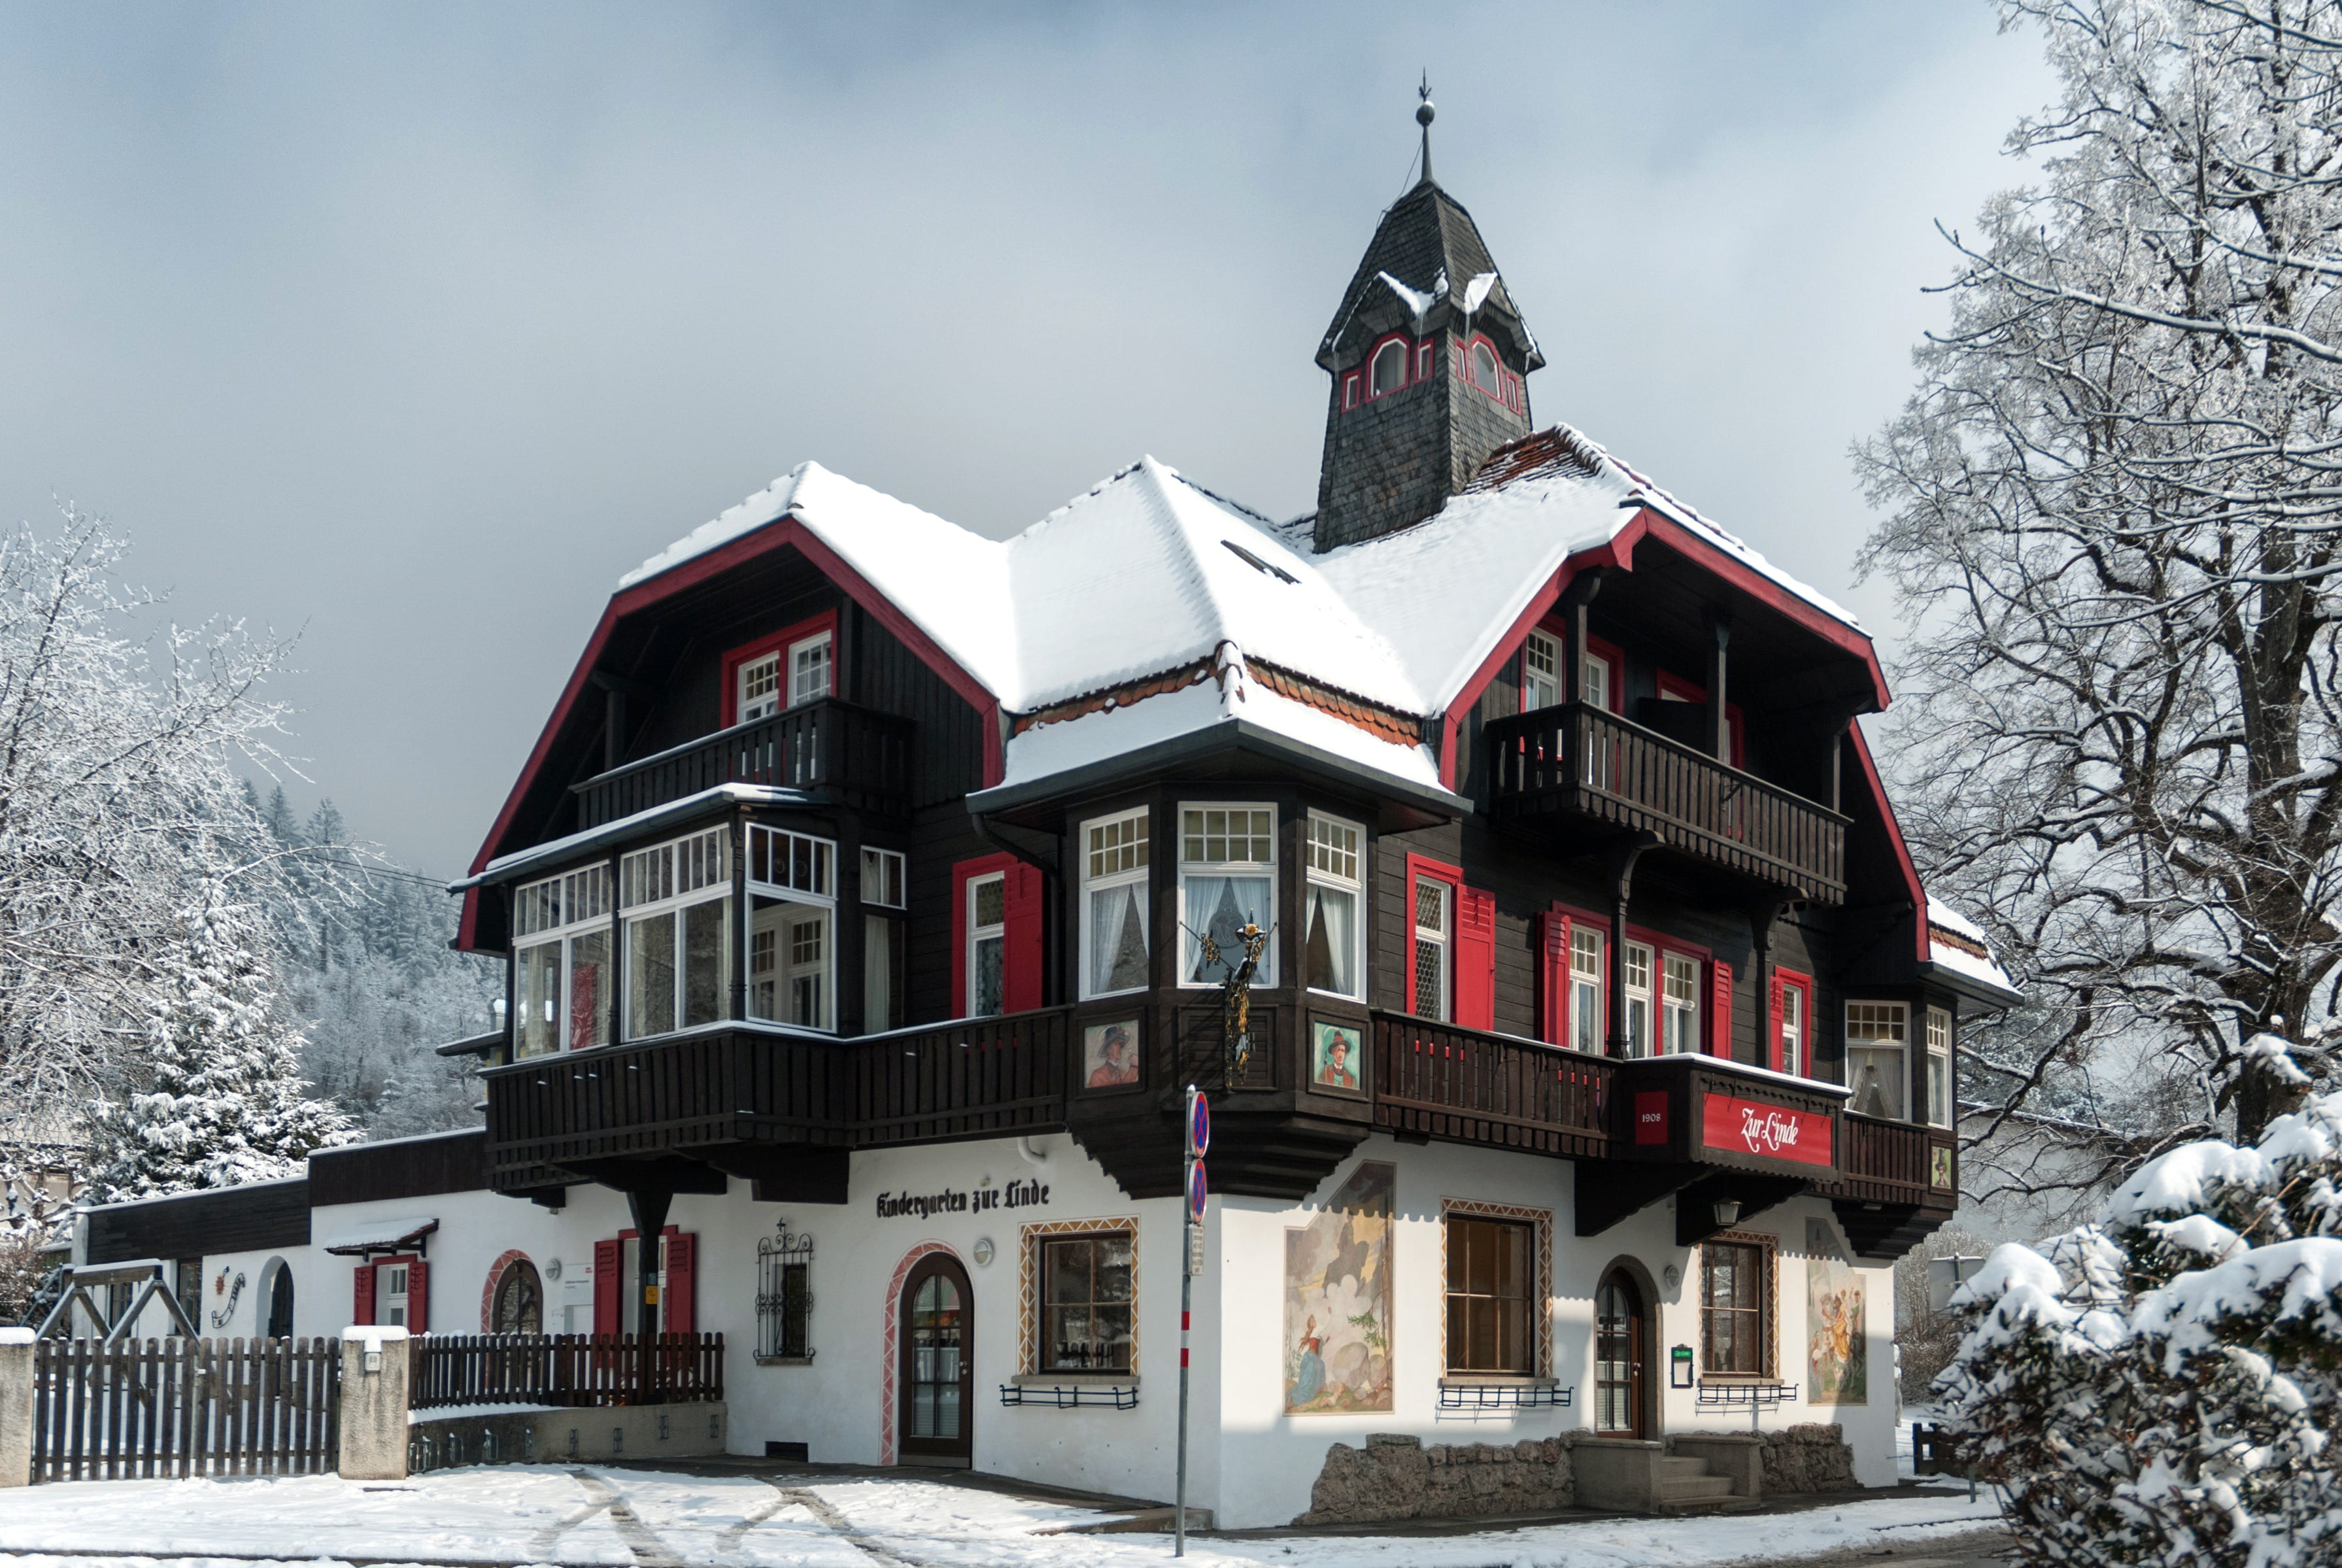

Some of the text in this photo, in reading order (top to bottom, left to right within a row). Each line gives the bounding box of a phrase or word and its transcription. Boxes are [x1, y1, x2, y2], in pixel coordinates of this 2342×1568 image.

[1642, 1113, 1661, 1123] 1908
[1740, 1108, 1799, 1153] Zur Linde
[876, 1178, 1049, 1220] Kindergarten zur Linde
